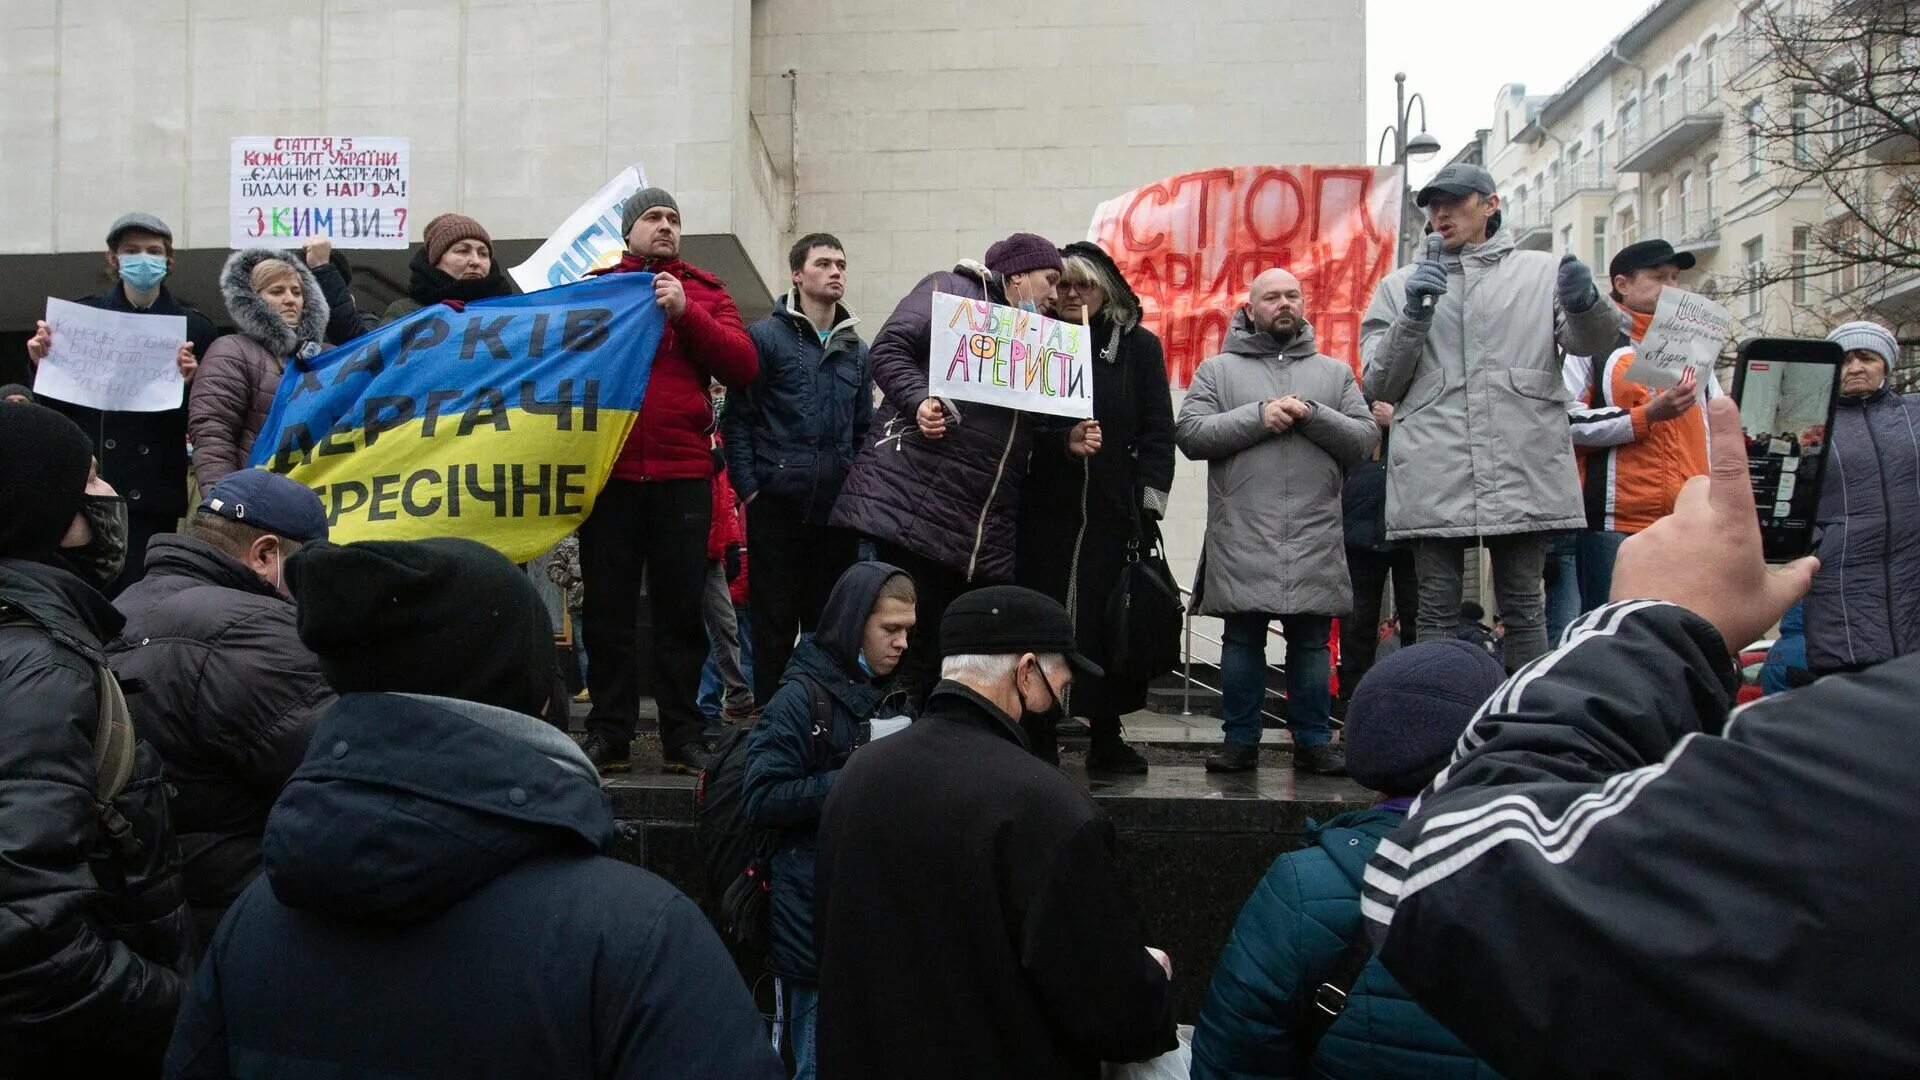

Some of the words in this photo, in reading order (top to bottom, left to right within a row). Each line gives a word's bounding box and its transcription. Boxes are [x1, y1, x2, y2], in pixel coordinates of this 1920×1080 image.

[273, 137, 333, 151] СТАТТЯ
[340, 138, 353, 151] 5
[329, 149, 397, 166] УКРАЇНИ
[242, 182, 297, 197] ВЛАДИ
[303, 183, 318, 197] Є
[326, 180, 407, 198] НАРОД!
[323, 167, 400, 181] ДЖЕРЕЛОМ
[272, 206, 333, 237] КИМ
[1122, 168, 1381, 251] СТОП
[949, 298, 1079, 353] ЛУБНИ-ГАЗ
[289, 307, 613, 400] ХАРКІВ
[269, 379, 601, 473] ДЕРГАЧІ
[312, 463, 586, 527] РЕСІЧНЕ
